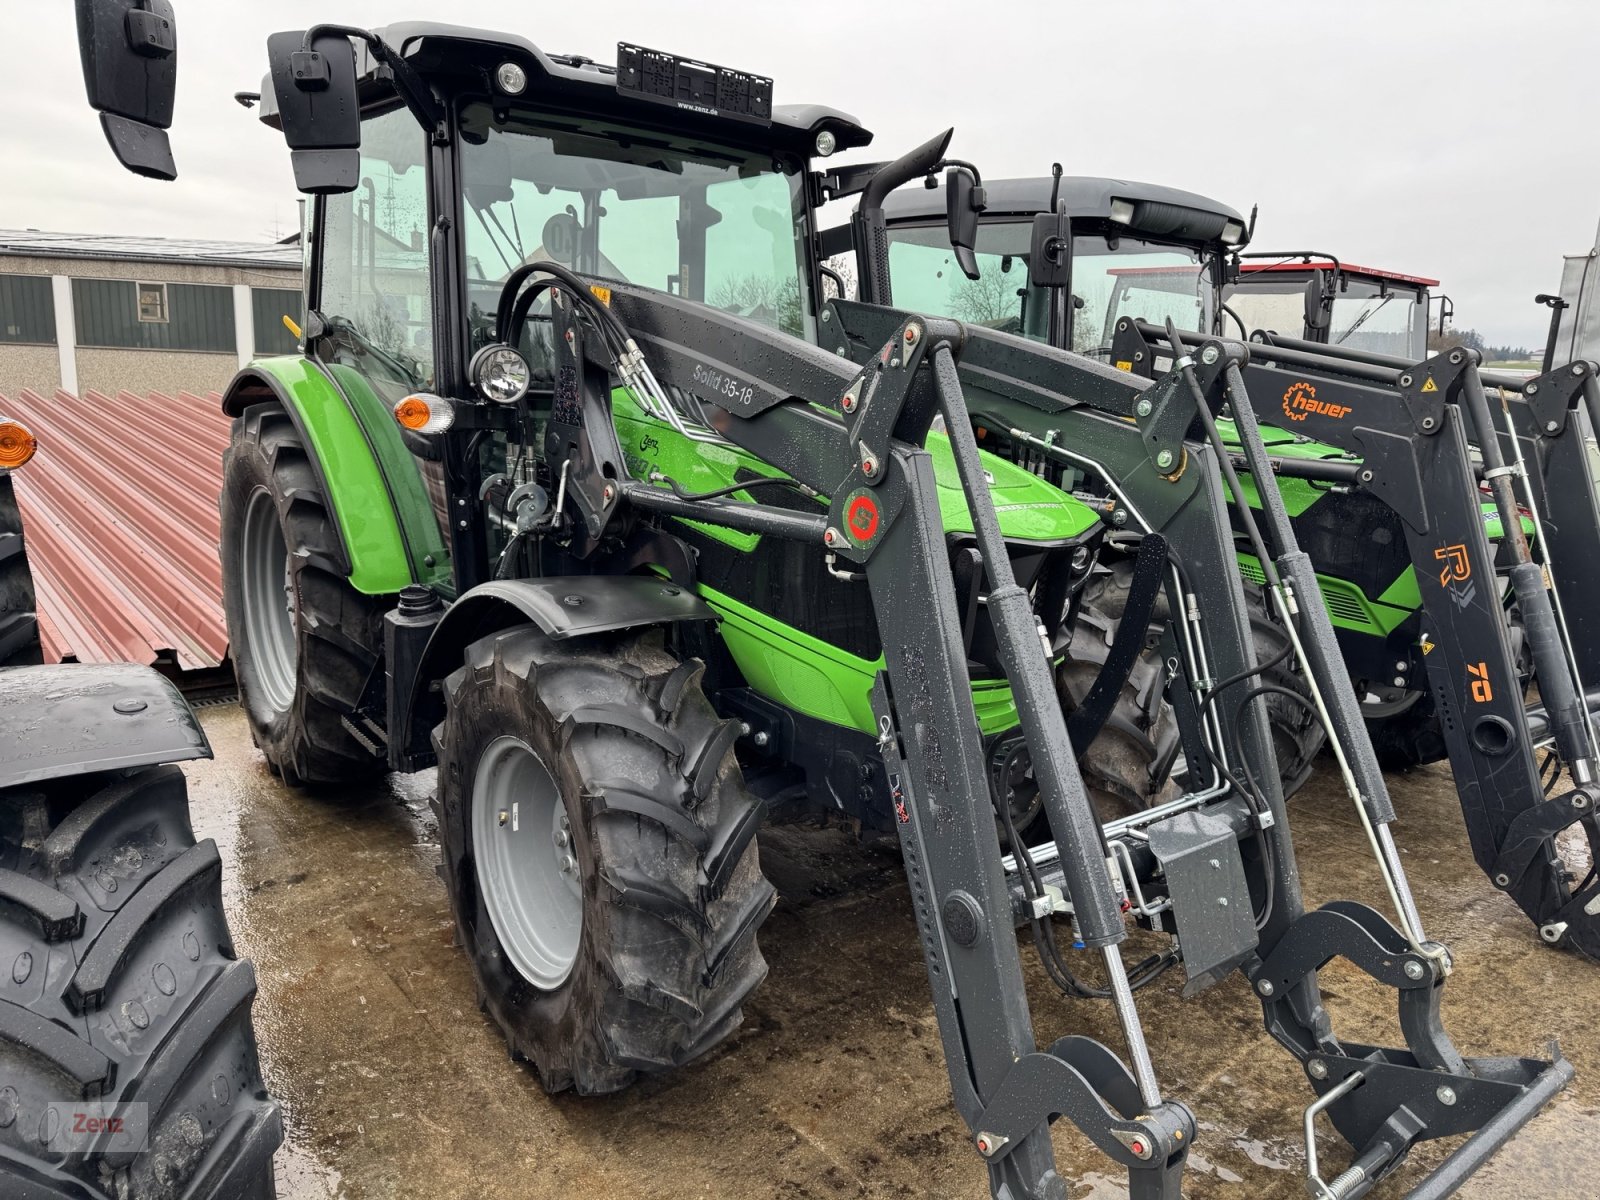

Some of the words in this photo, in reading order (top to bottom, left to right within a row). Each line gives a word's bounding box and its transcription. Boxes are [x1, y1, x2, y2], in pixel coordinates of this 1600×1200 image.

[677, 101, 718, 116] www.zenz.de
[693, 364, 722, 390] Solid
[721, 377, 753, 405] 35-18
[1292, 390, 1353, 419] hauer
[640, 434, 659, 457] Zenz
[1467, 662, 1493, 703] 70
